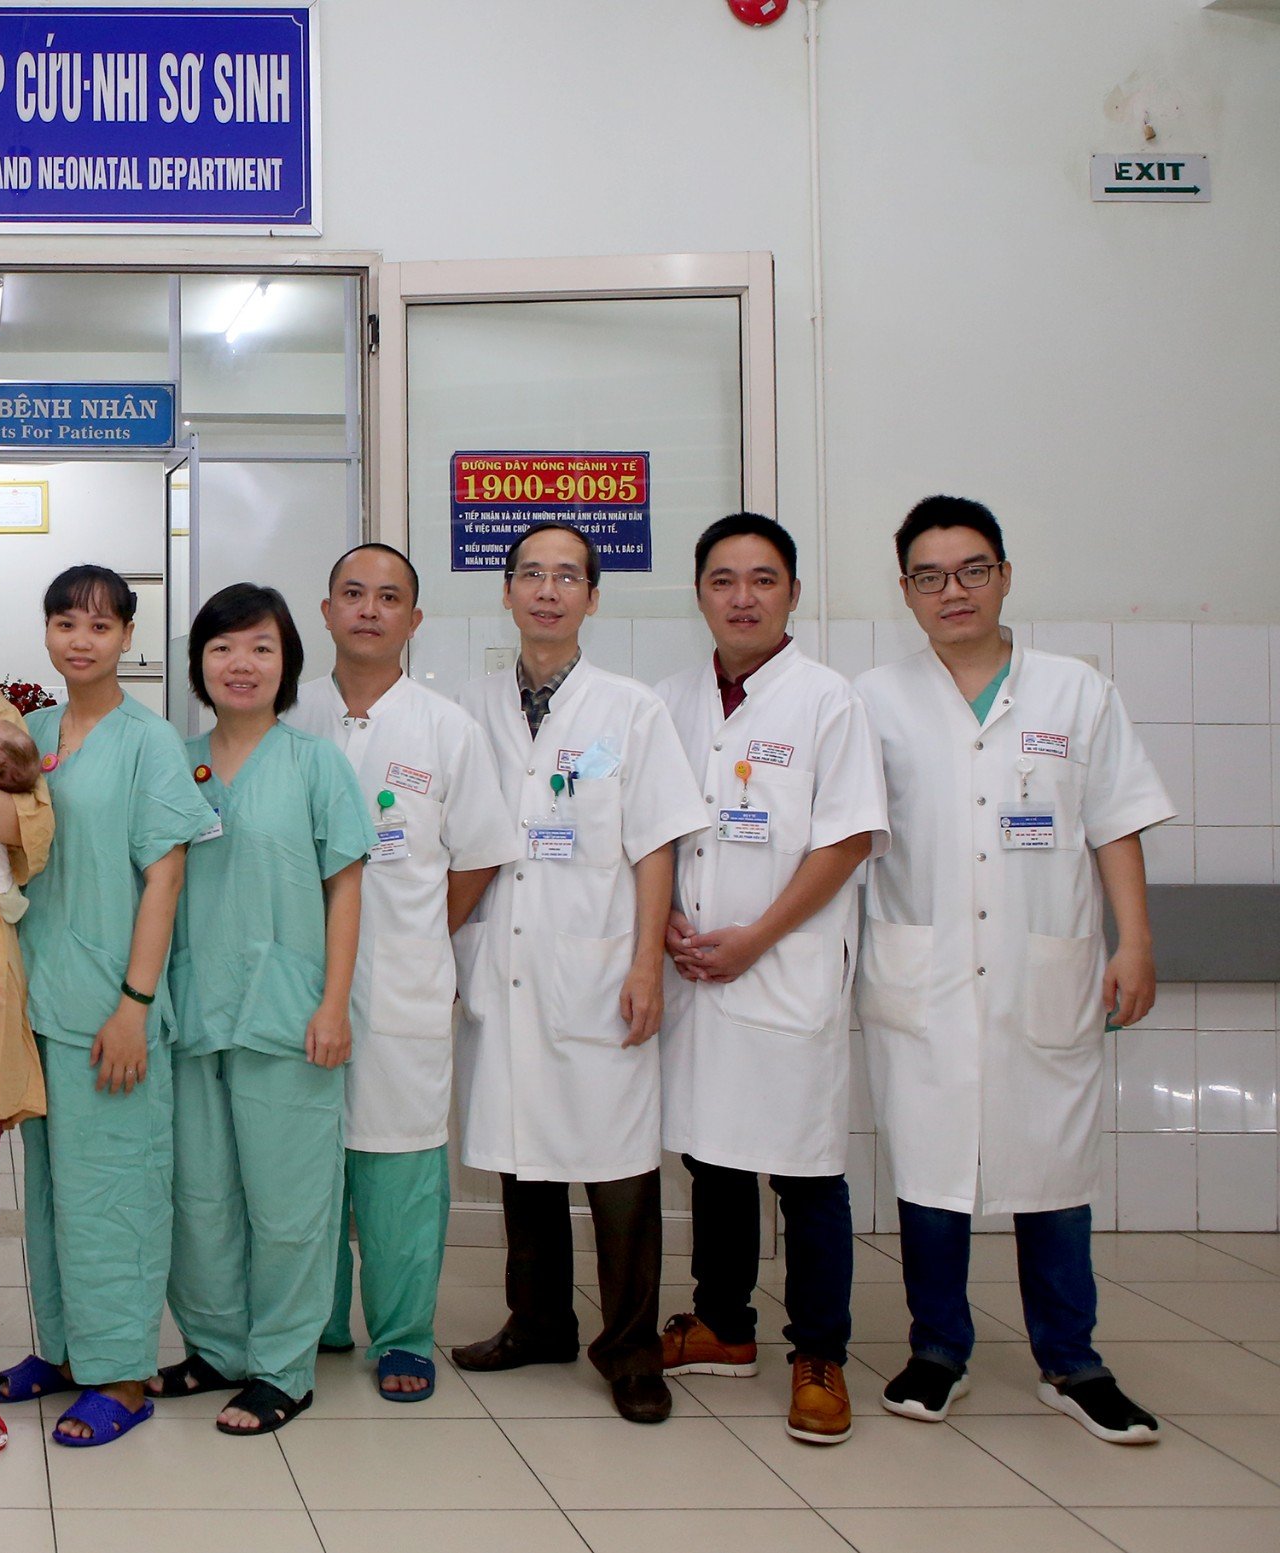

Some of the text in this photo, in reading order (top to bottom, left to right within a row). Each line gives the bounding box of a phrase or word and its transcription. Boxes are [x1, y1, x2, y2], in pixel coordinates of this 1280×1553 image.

[158, 52, 204, 123] SƠ
[213, 53, 290, 123] SINH
[38, 156, 143, 190] NEONATAL
[148, 157, 283, 191] DEPARTMENT
[1115, 162, 1185, 181] EXIT
[81, 393, 158, 419] NHÂN
[21, 425, 53, 439] For
[58, 425, 131, 440] Patients
[461, 459, 638, 471] ĐƯỜNG DÂY NÓNG NGÀNH Y TẾ
[463, 474, 637, 500] 1900-9095
[464, 510, 480, 520] TIẾP
[481, 510, 500, 522] NHẬN
[501, 510, 510, 520] VÀ
[512, 510, 523, 520] XỬ
[523, 510, 531, 520] LÝ
[532, 510, 556, 520] NHỮNG
[593, 510, 607, 520] CỦA
[608, 510, 627, 520] NHÂN
[475, 524, 490, 534] VIỆC
[491, 523, 512, 533] KHÁM
[580, 524, 590, 533] CƠ
[590, 522, 601, 533] SỞ
[602, 525, 607, 533] Y
[481, 544, 504, 553] DƯƠNG
[622, 543, 635, 553] BÁC
[465, 555, 483, 565] NHÂN
[485, 555, 500, 565] VIÊN
